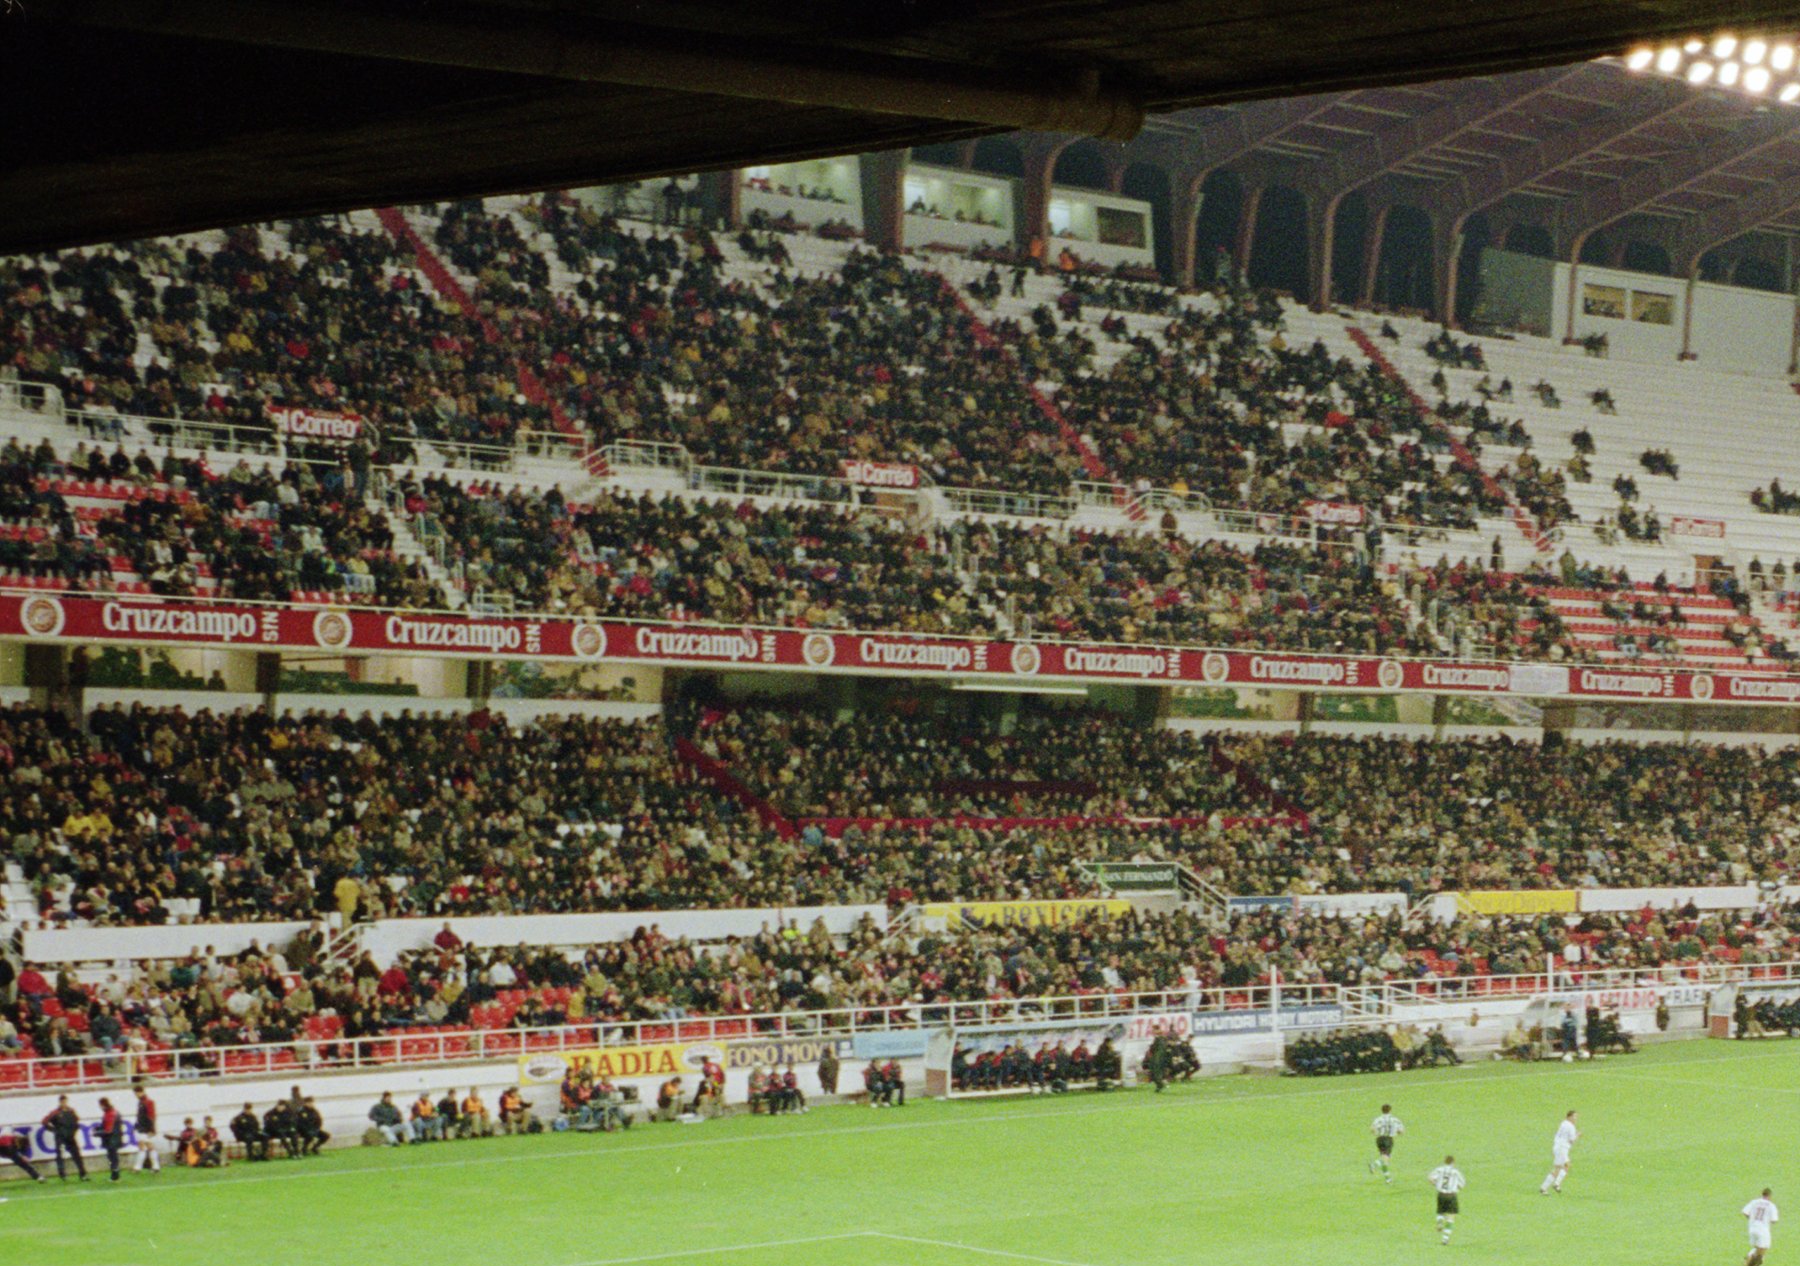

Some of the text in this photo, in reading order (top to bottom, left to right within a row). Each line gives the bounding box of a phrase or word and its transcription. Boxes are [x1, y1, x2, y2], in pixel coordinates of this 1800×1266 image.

[102, 602, 256, 642] Cruzcampo
[385, 616, 521, 653] Cruzcampo
[635, 627, 759, 661] Cruzcampo
[860, 638, 971, 670] Cruzcampo
[1064, 648, 1166, 678] Cruzcampo
[1249, 656, 1344, 685] Cruzcampo
[781, 1040, 839, 1063] MOVL
